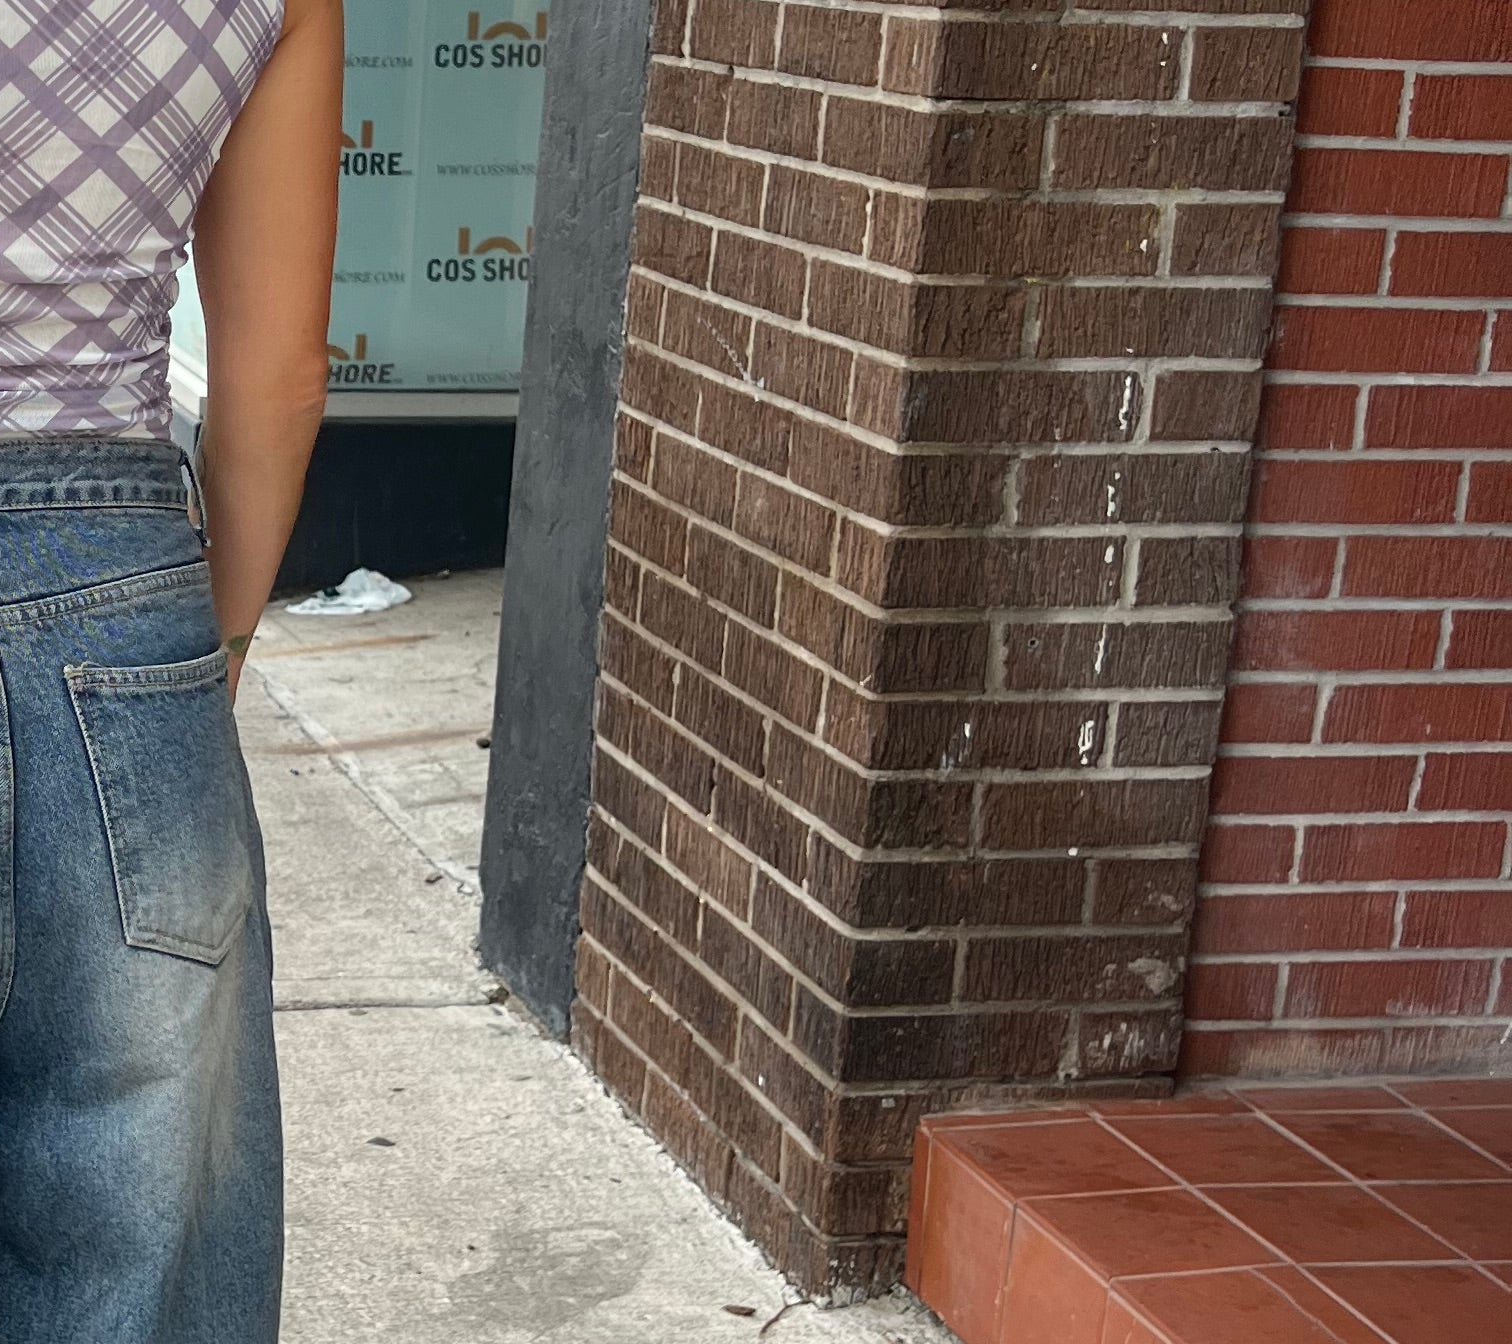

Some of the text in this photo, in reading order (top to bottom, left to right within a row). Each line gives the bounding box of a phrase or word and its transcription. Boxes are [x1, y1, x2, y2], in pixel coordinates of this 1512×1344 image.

[434, 43, 484, 69] COS
[491, 44, 547, 69] SHO
[339, 152, 403, 176] HORE
[426, 258, 476, 283] COS
[483, 258, 529, 283] SHO
[327, 363, 395, 384] HORE
